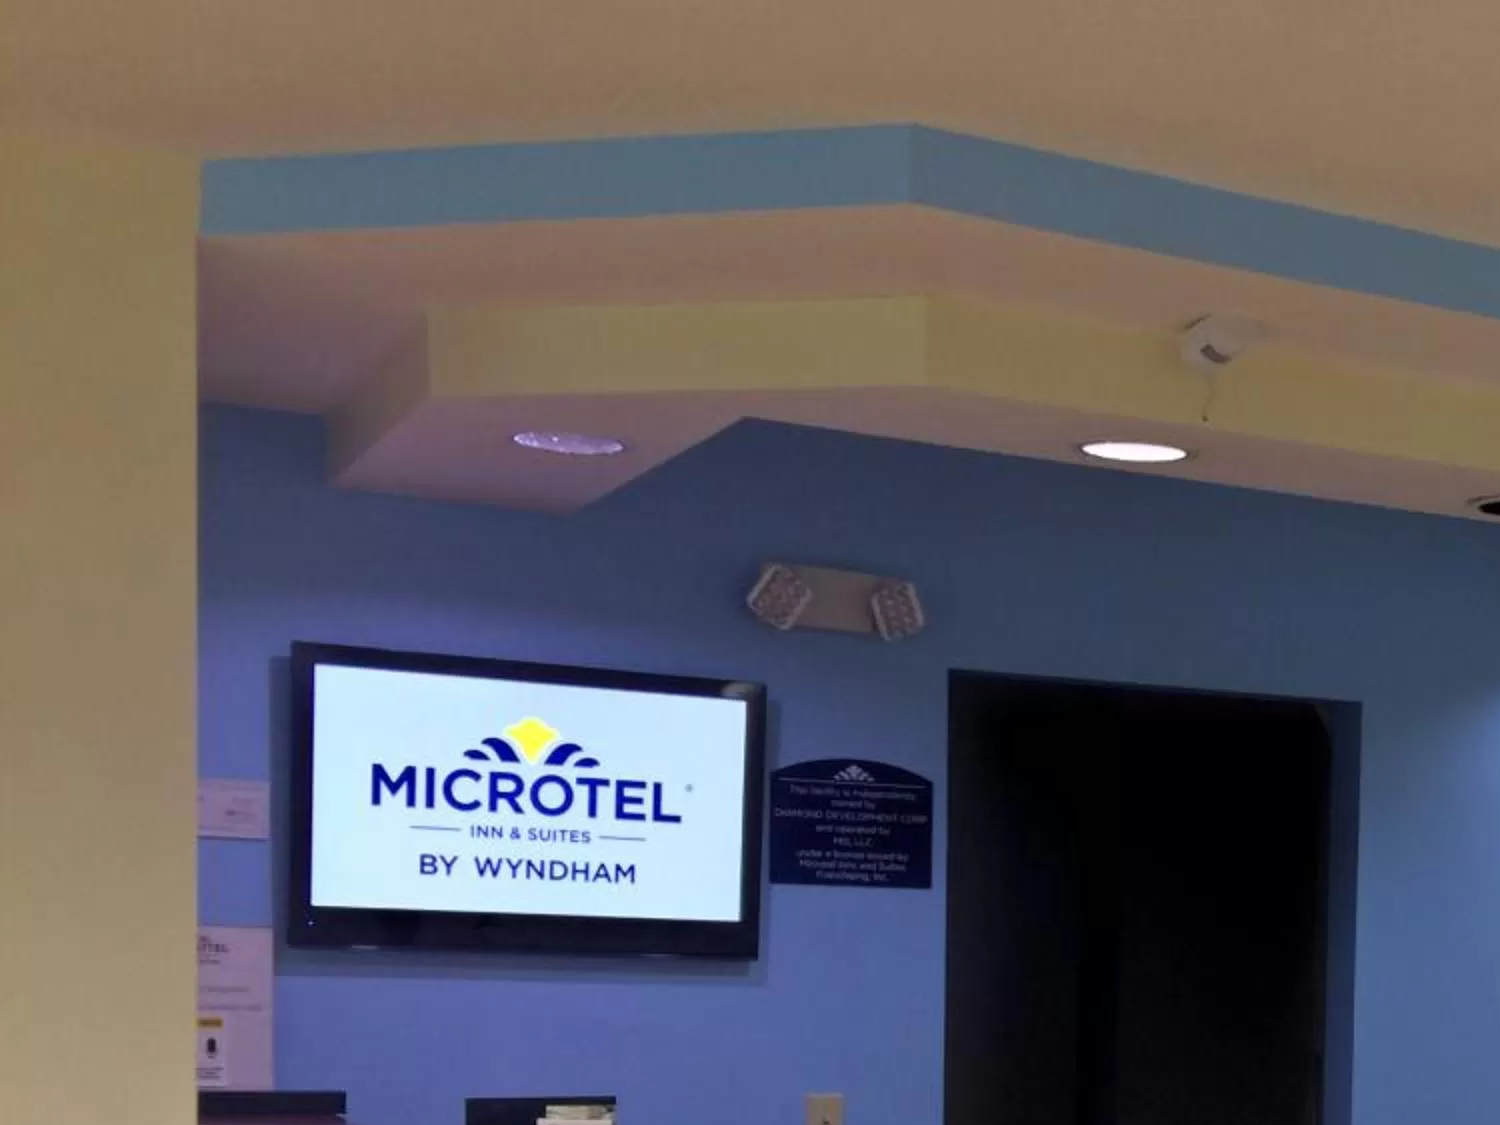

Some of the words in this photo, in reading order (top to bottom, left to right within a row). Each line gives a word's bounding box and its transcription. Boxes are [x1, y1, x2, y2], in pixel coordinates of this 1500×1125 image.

[371, 763, 682, 824] MICROTEL
[469, 824, 503, 839] INN
[509, 827, 522, 840] &
[527, 827, 592, 843] SUITES
[419, 853, 459, 876] BY
[474, 856, 637, 884] WYNDHAM
